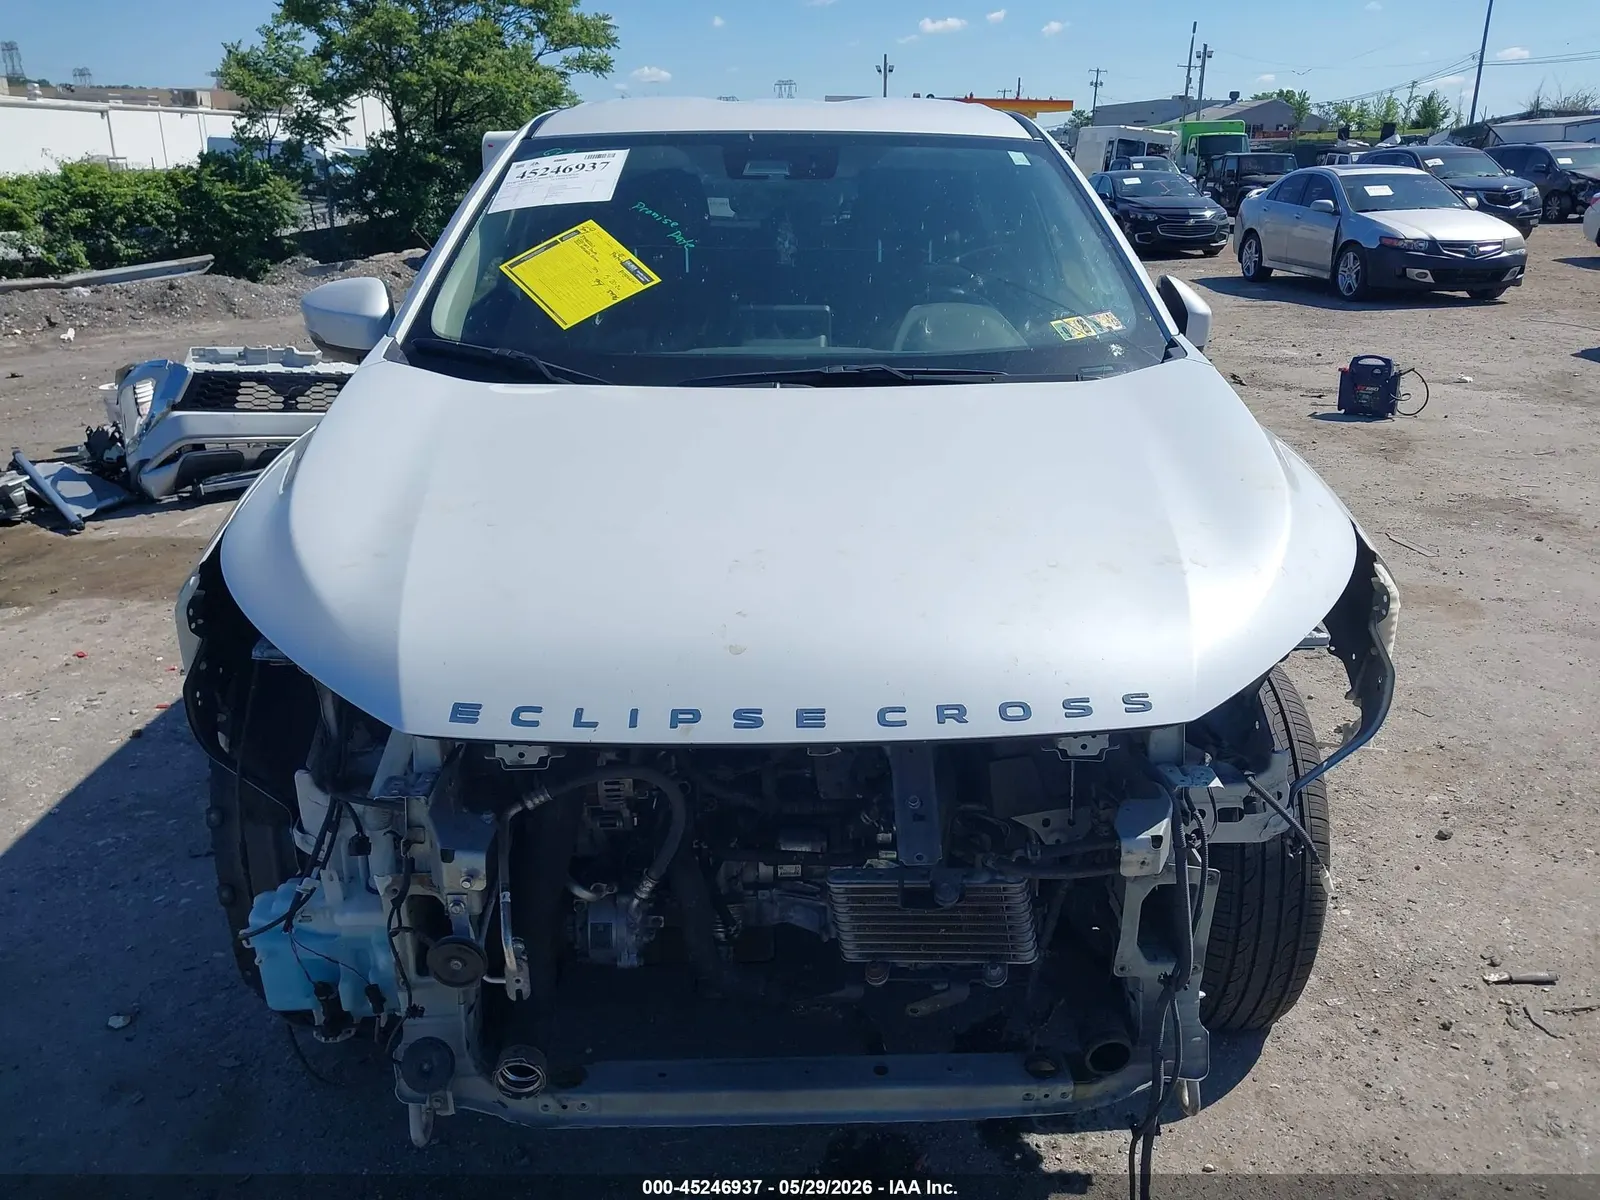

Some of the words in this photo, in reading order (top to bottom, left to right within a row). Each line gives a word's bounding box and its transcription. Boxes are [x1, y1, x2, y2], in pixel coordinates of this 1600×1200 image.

[515, 161, 611, 181] 45246937
[448, 701, 827, 730] ECLIPSE
[876, 692, 1153, 728] CROSS
